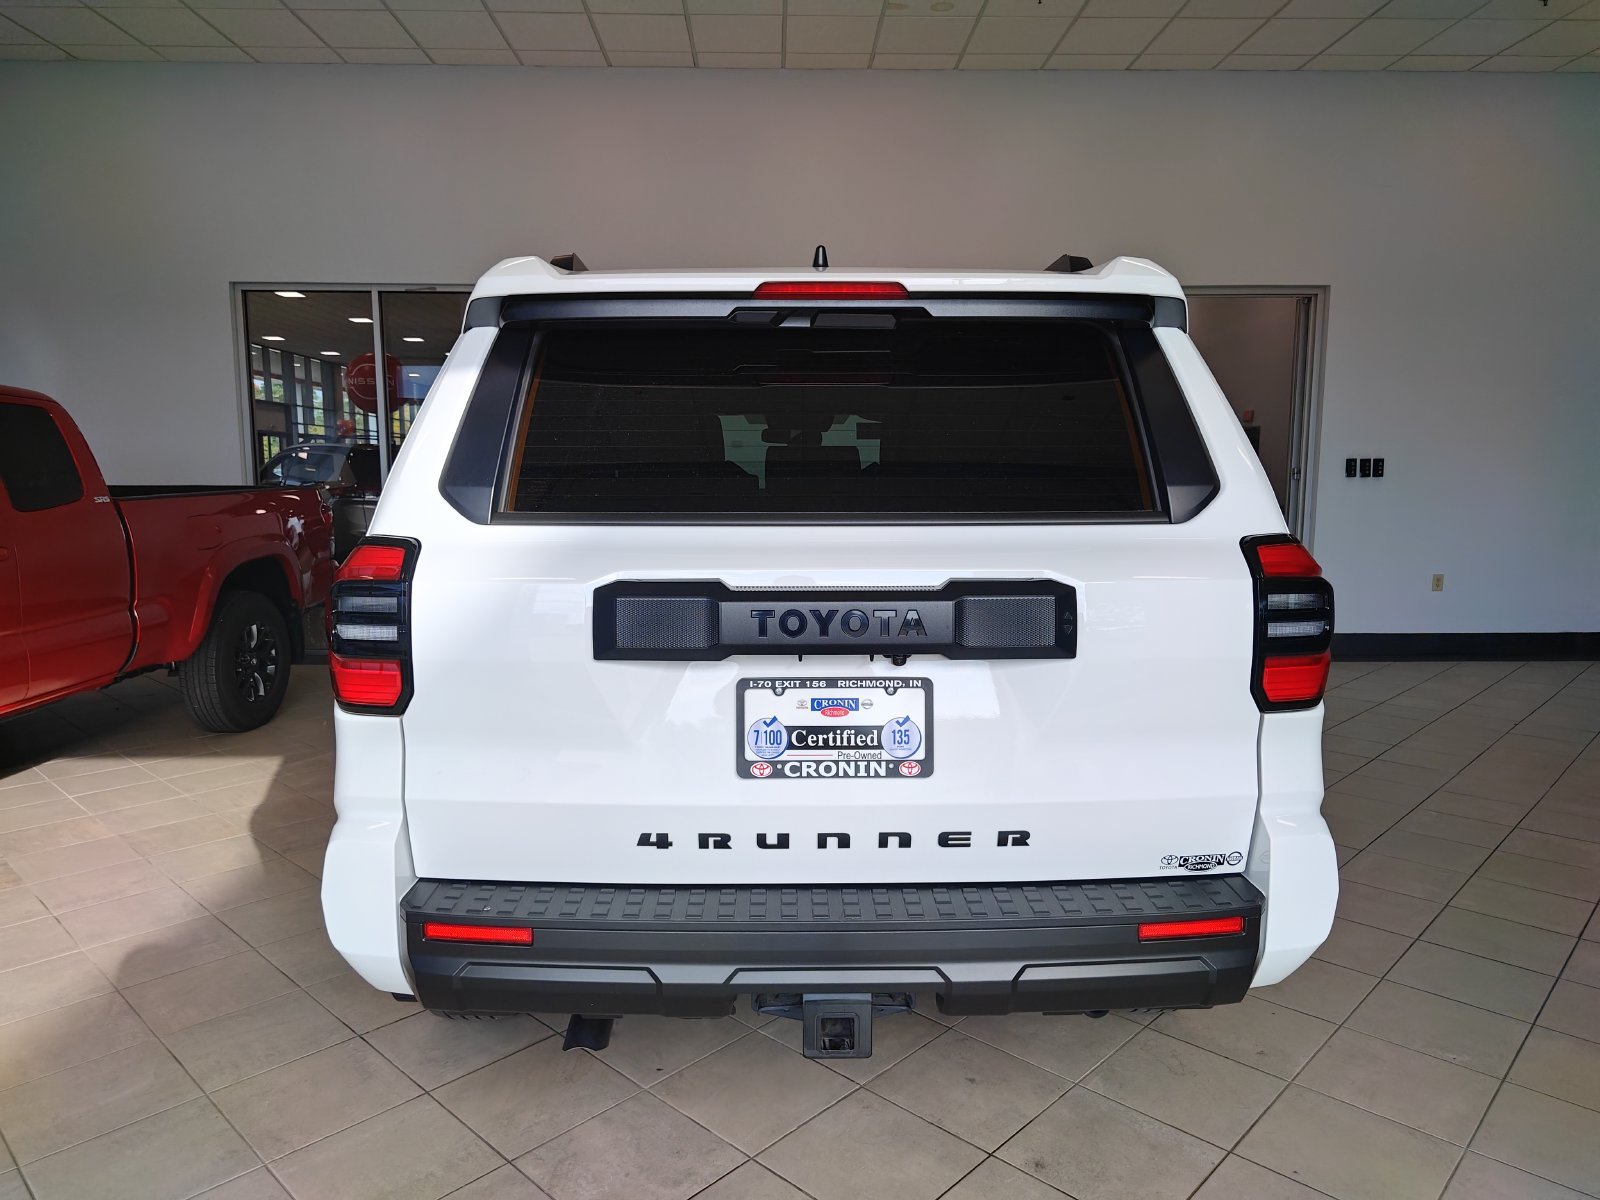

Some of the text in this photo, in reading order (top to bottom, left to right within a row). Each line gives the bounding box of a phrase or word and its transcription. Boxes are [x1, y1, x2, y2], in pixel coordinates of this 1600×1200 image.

[348, 378, 395, 386] NISSN
[750, 609, 928, 638] TOYOTA
[837, 680, 905, 688] RICHMOND,
[814, 700, 856, 710] CRONIN
[791, 729, 879, 746] Certified
[891, 729, 910, 745] 135
[837, 751, 882, 760] Pre-Owned
[784, 761, 886, 777] CRONIN
[636, 830, 1031, 850] 4RUNNER
[1180, 854, 1225, 865] CRONIN
